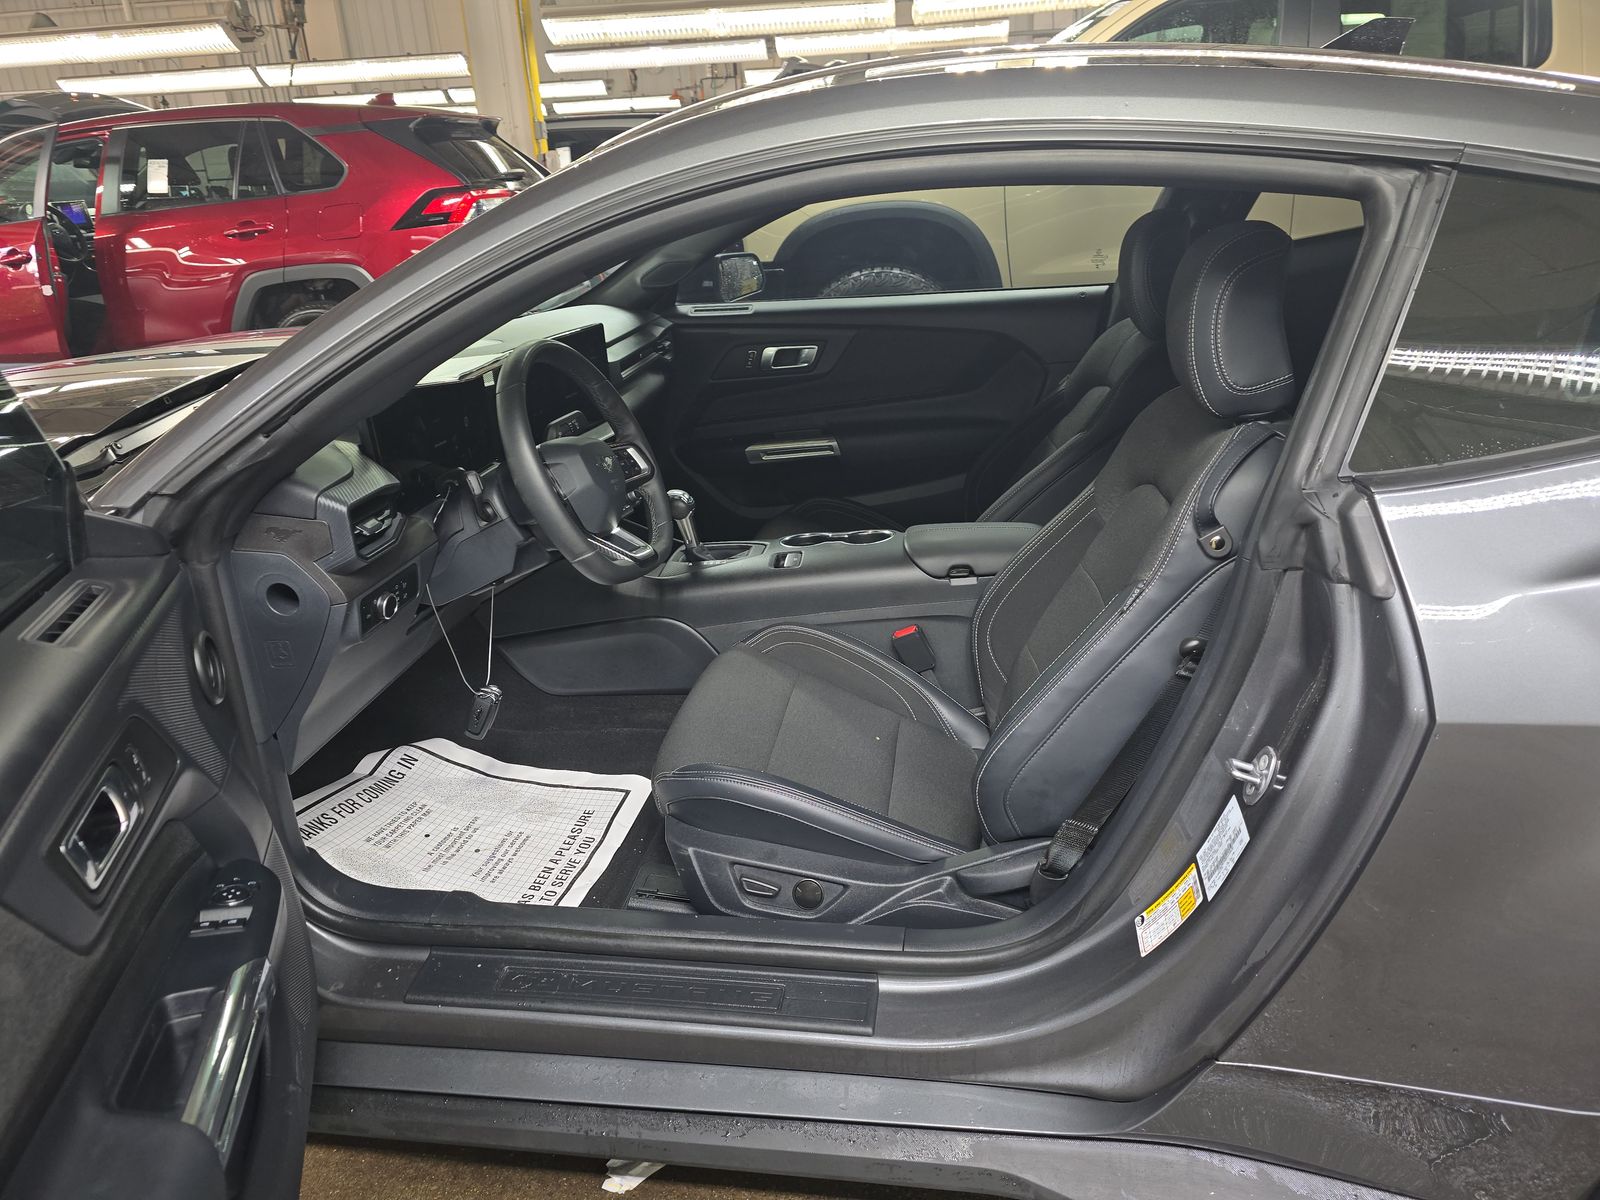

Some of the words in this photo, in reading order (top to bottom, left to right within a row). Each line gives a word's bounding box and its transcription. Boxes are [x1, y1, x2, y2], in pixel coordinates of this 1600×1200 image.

[300, 813, 338, 840] ANKS
[331, 799, 364, 818] FOR
[356, 769, 406, 804] COMING
[397, 753, 419, 770] IN
[372, 827, 387, 838] HAVE
[384, 816, 400, 828] TRIED
[405, 801, 418, 811] KEEP
[373, 836, 386, 846] YOUR
[386, 815, 413, 837] CARPETING
[411, 804, 428, 816] CLEAN
[383, 839, 397, 848] WITH
[396, 829, 410, 839] THIS
[406, 816, 424, 830] PAPER
[422, 864, 434, 872] the
[431, 852, 446, 864] most
[442, 831, 467, 853] important
[463, 816, 481, 831] person
[454, 839, 469, 853] world
[470, 867, 484, 877] Your
[482, 838, 508, 867] suggestions
[480, 858, 504, 882] improving
[500, 848, 510, 857] our
[508, 831, 525, 847] service
[528, 866, 555, 891] BEEN
[555, 809, 595, 857] PLEASURE
[497, 857, 514, 874] always
[539, 890, 557, 901] TO
[551, 858, 581, 887] SERVE
[574, 836, 596, 855] YOU
